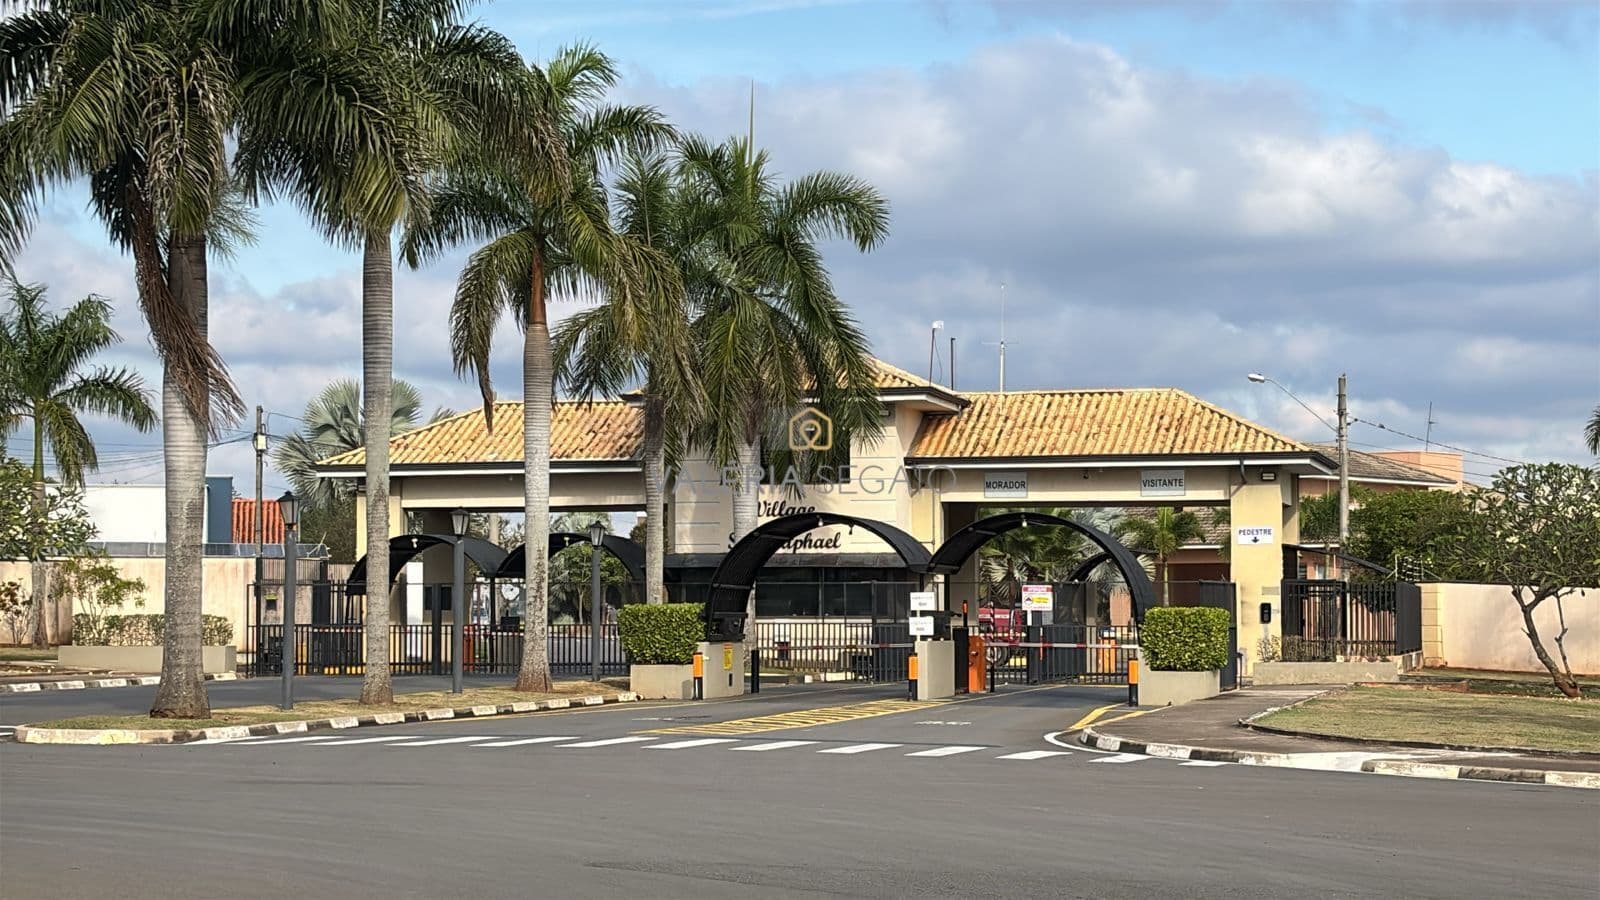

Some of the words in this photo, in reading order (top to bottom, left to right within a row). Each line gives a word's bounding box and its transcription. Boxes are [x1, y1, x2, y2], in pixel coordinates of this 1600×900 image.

[985, 480, 1026, 490] MORADOR
[1142, 478, 1184, 488] VISITANTE
[757, 500, 816, 518] Village
[1238, 528, 1272, 536] PEDESTRE
[781, 532, 842, 554] aphael
